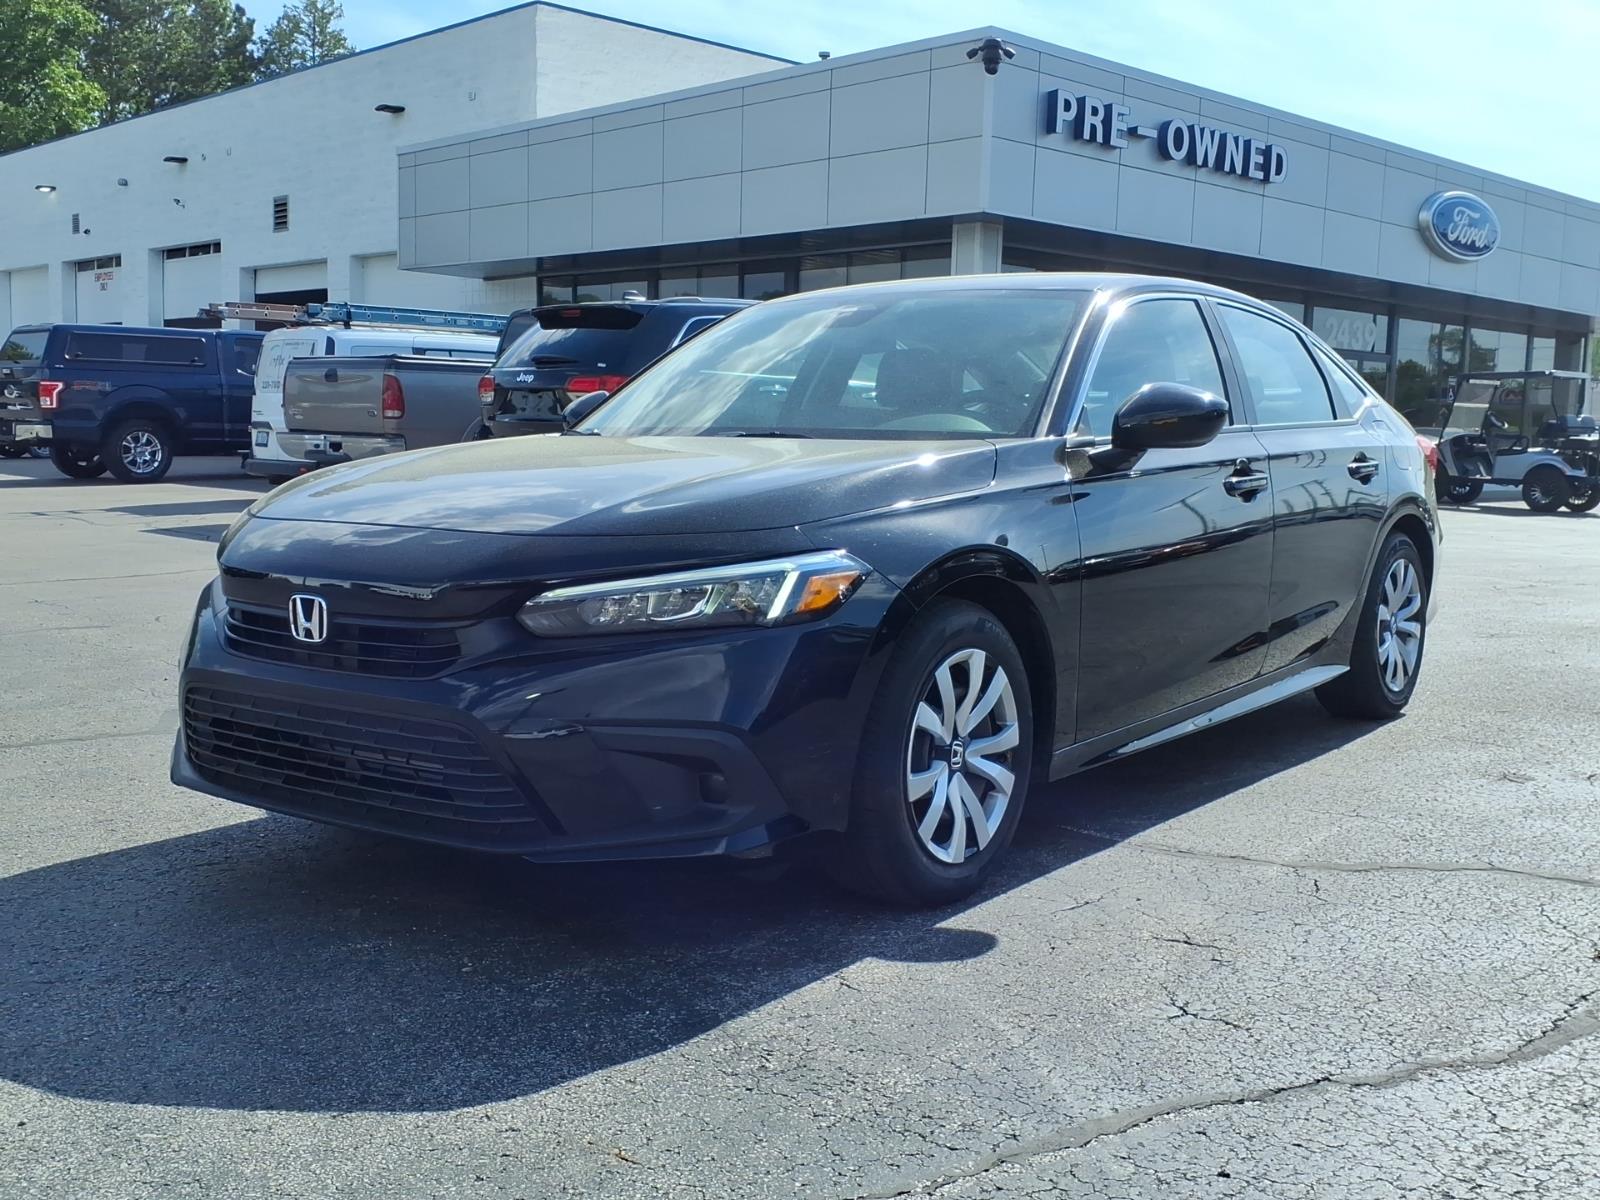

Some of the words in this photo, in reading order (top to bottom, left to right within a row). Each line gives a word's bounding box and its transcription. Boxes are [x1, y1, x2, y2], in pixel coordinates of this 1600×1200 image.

[1448, 206, 1490, 249] Ford
[1324, 316, 1377, 352] 2439
[516, 372, 534, 383] Jeep
